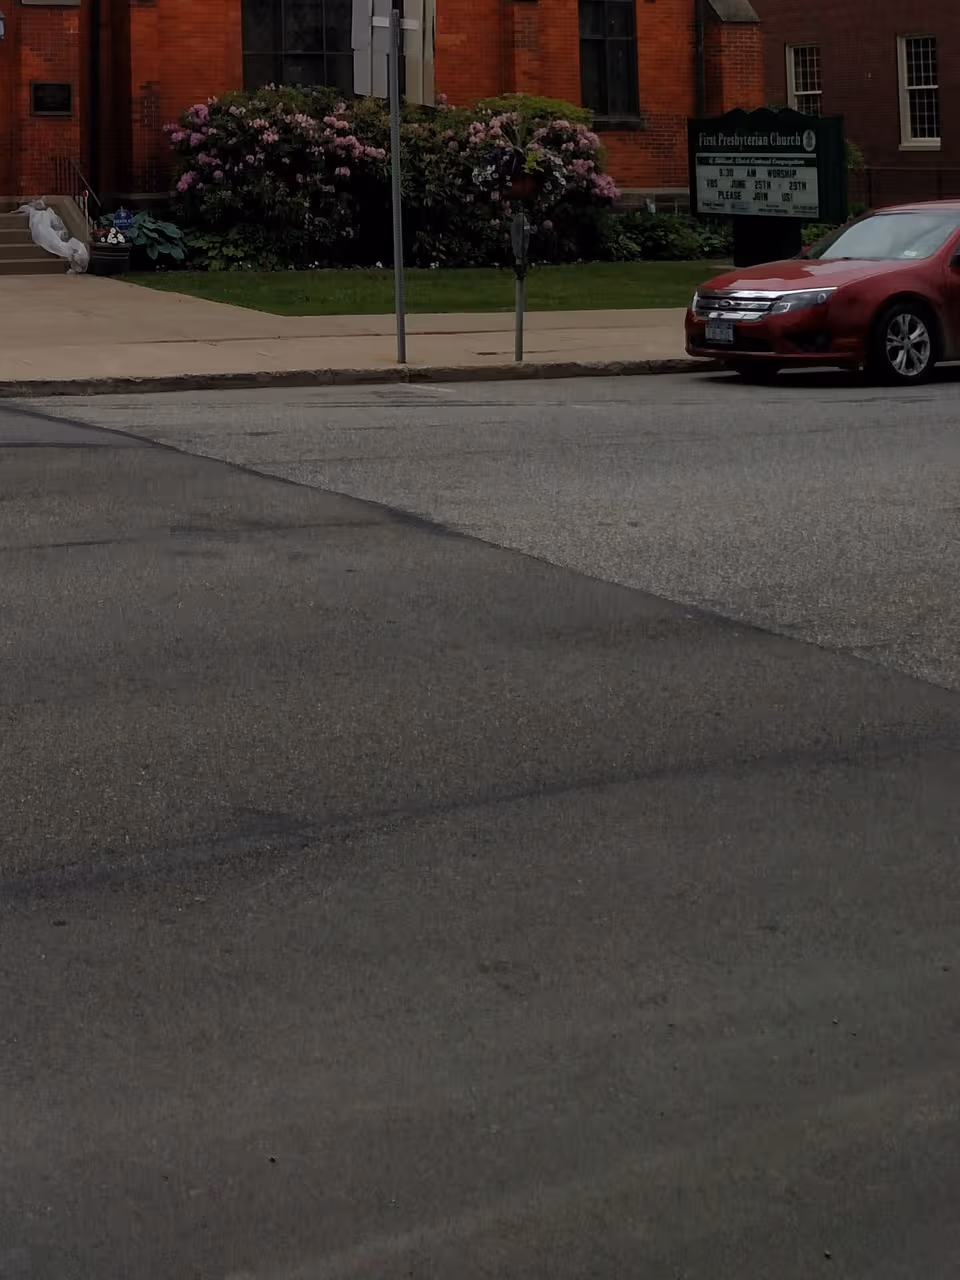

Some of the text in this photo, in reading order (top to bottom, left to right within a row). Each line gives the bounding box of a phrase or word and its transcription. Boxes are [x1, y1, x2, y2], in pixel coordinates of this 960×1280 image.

[698, 131, 801, 151] First Presbyterian Church
[719, 168, 797, 179] 9:30 AM WORSHIP
[754, 181, 771, 190] 25TH
[718, 191, 742, 201] PLEASE
[752, 192, 768, 202] JOIN
